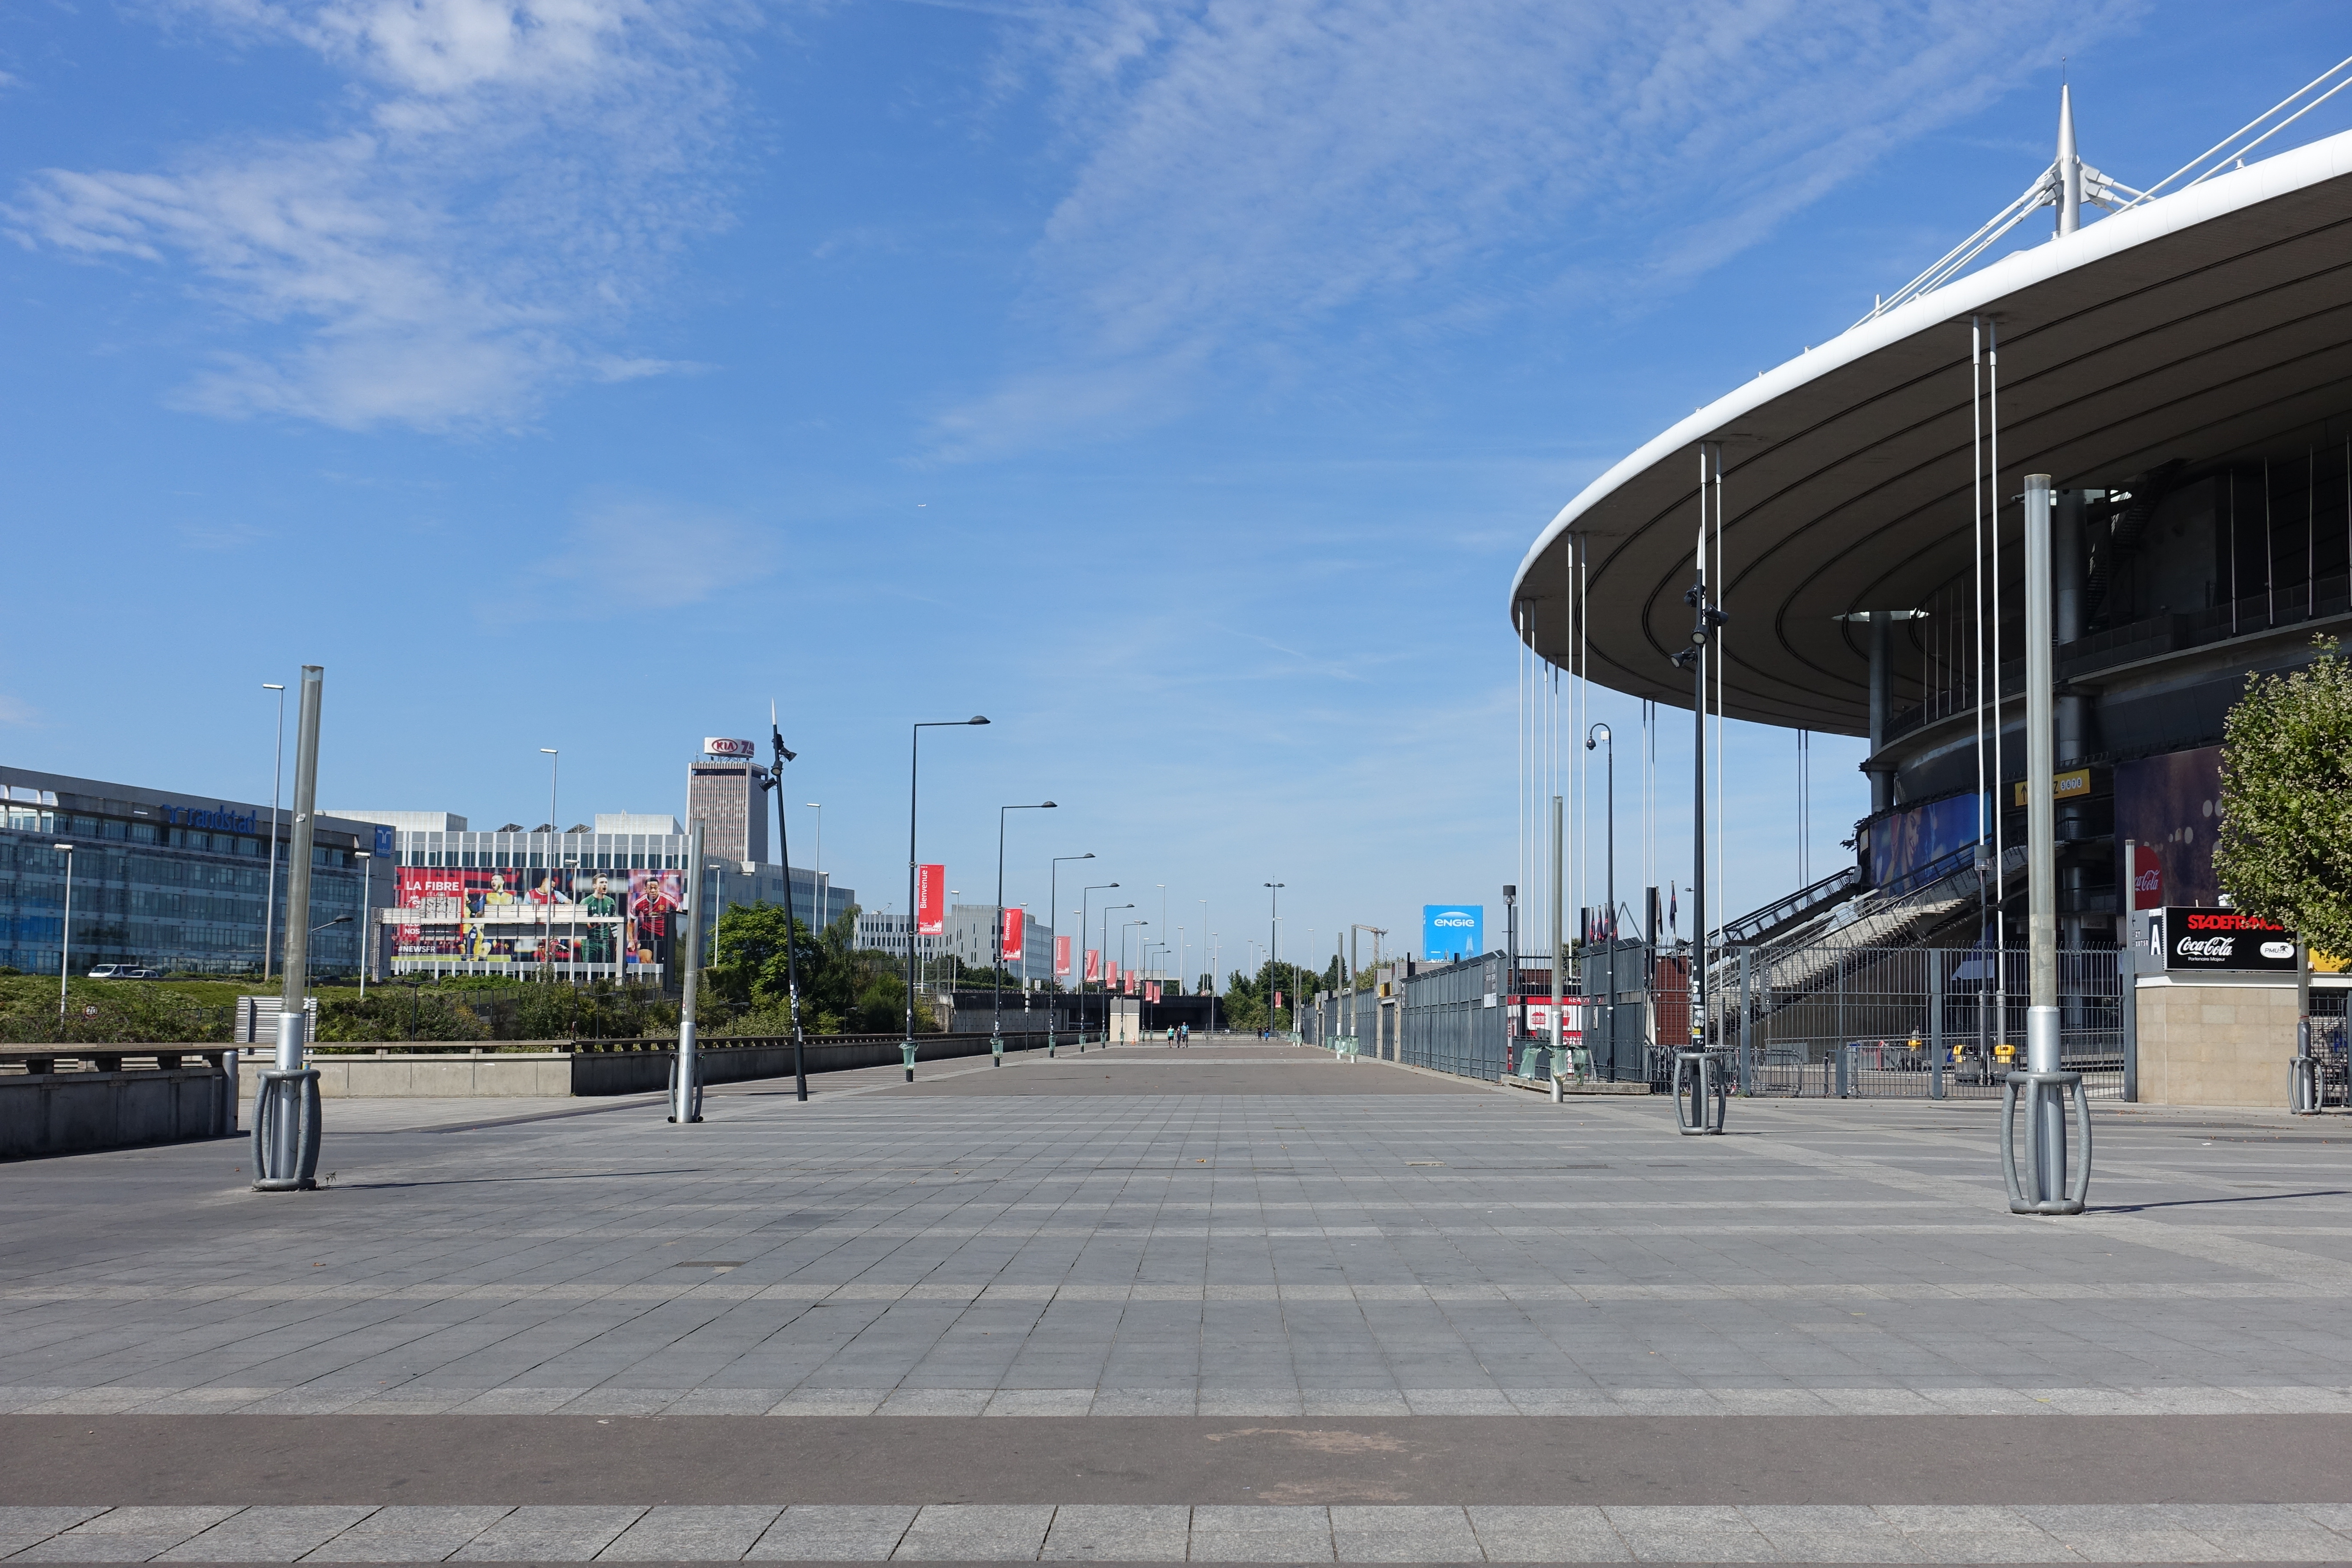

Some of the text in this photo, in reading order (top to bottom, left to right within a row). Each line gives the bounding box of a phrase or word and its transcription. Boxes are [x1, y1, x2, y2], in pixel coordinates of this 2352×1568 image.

[717, 741, 734, 750] KIA
[188, 805, 256, 834] randstad
[406, 881, 459, 891] LA FIBRE
[2150, 925, 2161, 956] A
[2177, 937, 2236, 956] Coca-Cola
